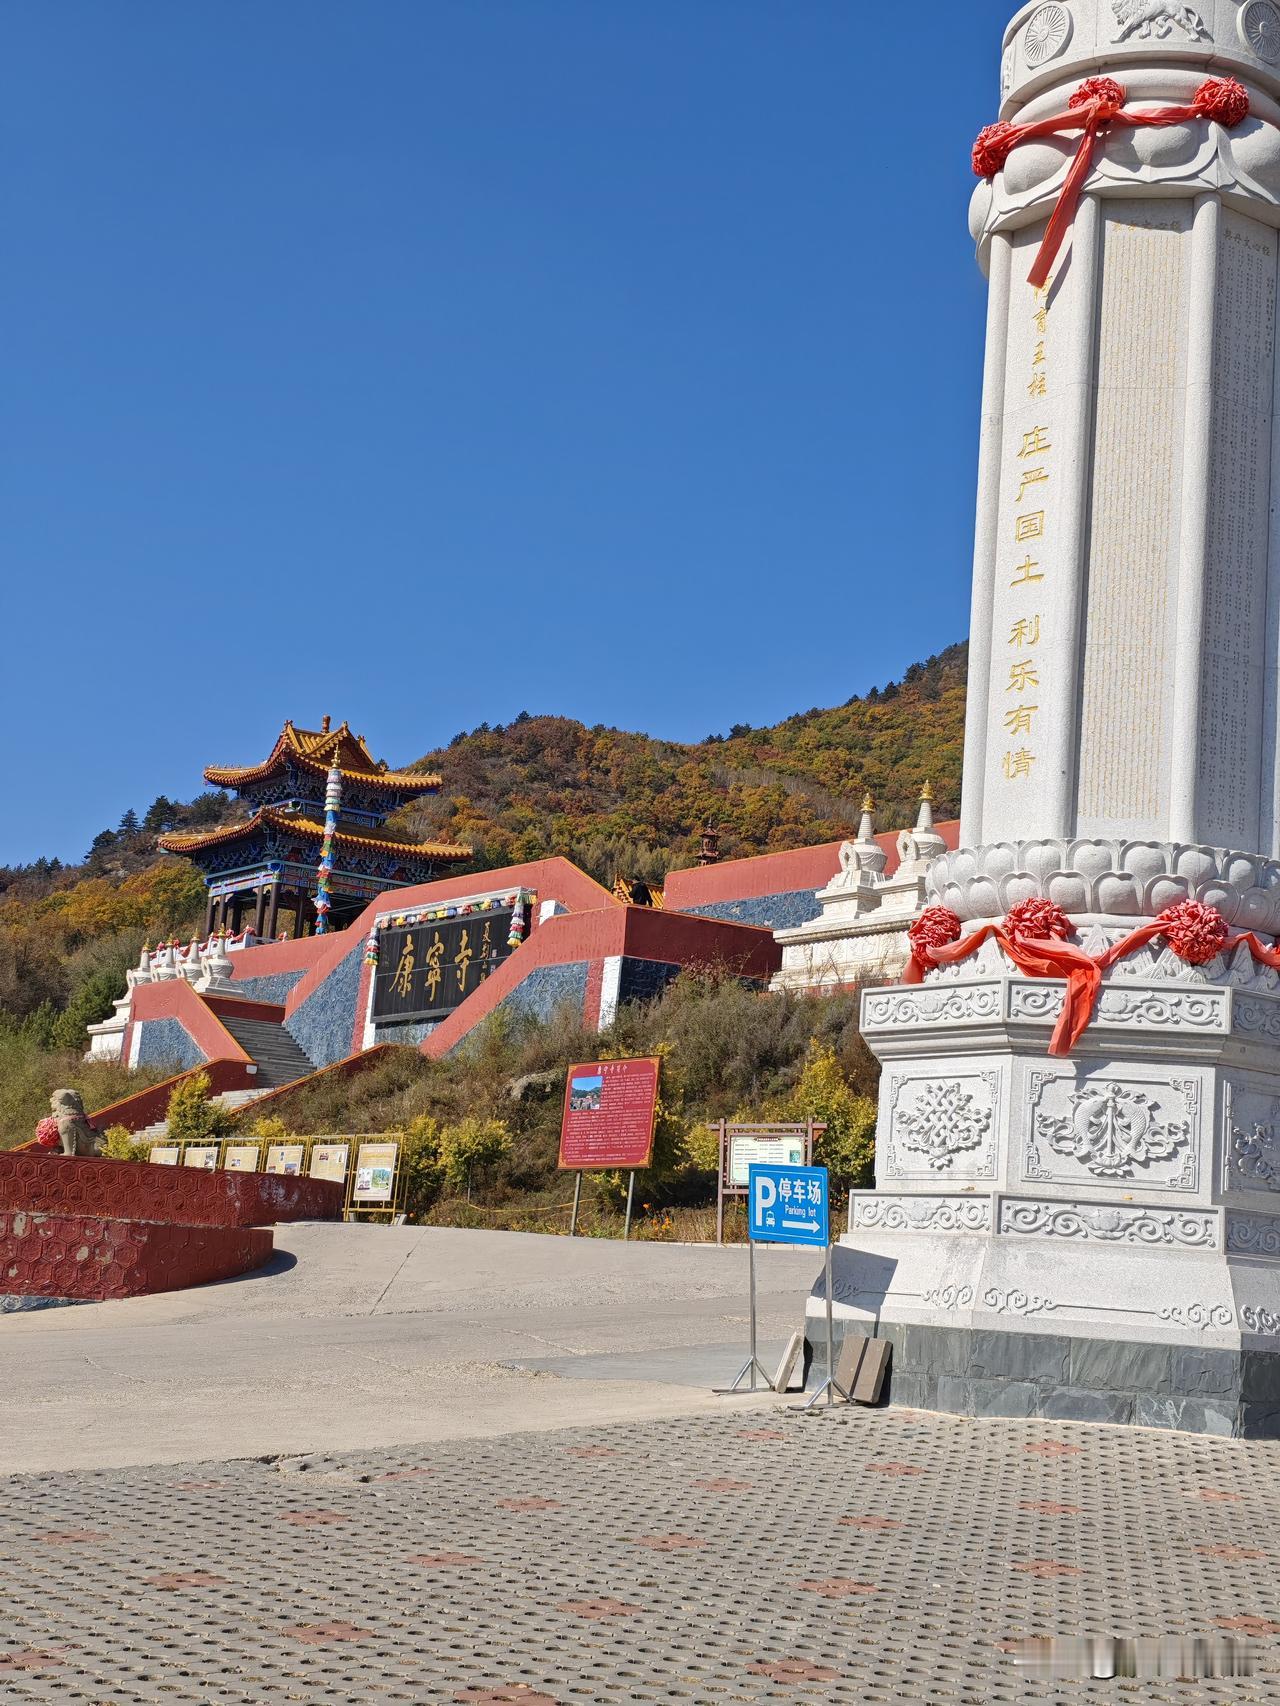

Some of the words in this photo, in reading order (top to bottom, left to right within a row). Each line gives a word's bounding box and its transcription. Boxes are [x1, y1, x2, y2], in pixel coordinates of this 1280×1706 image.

[1010, 425, 1051, 588] 庄严国土
[1002, 614, 1040, 779] 利乐有情
[756, 1176, 776, 1226] P
[778, 1177, 821, 1205] 停车场
[785, 1205, 806, 1218] Parking
[808, 1207, 817, 1217] lot
